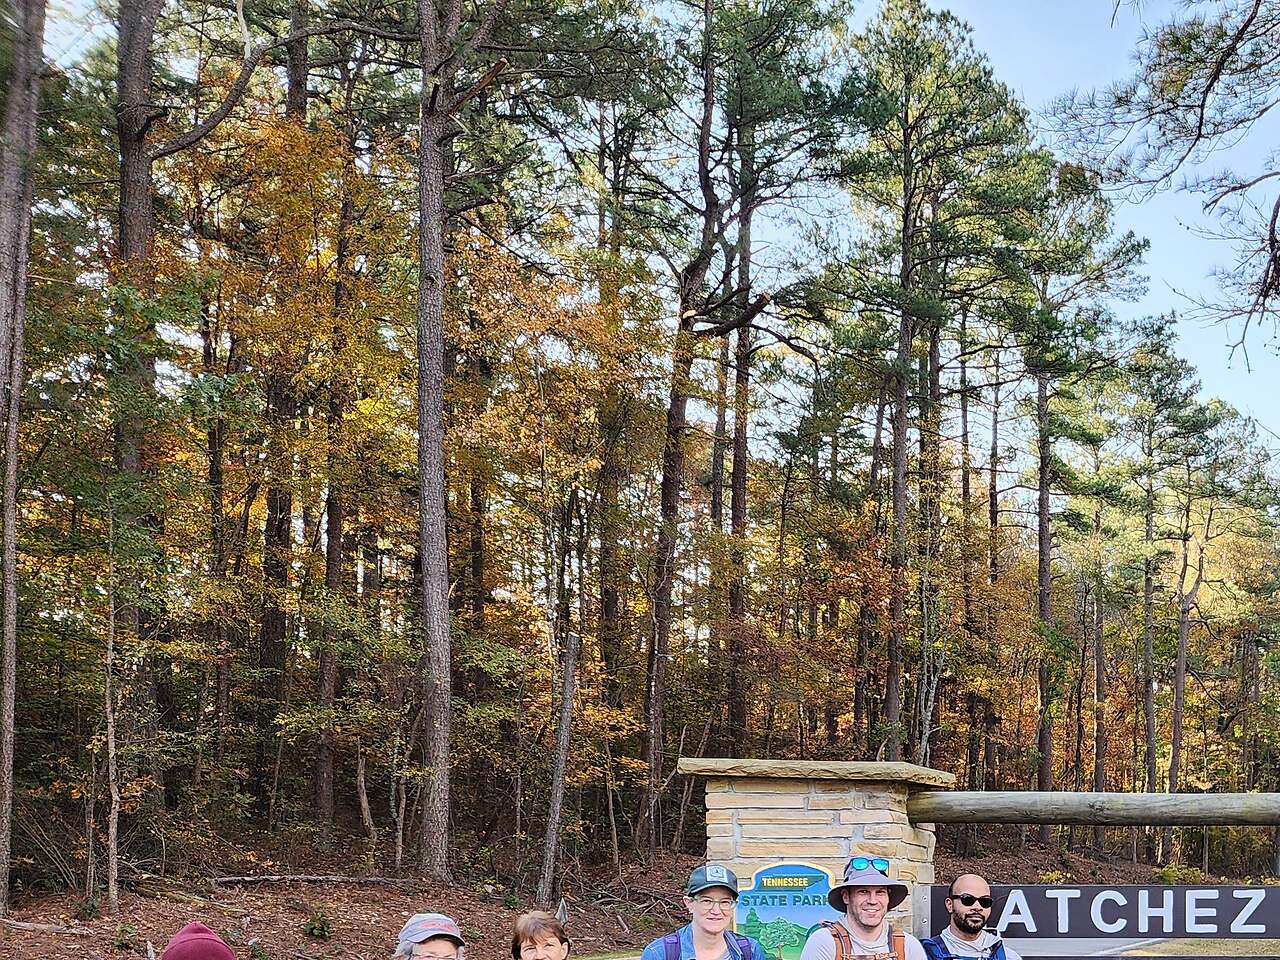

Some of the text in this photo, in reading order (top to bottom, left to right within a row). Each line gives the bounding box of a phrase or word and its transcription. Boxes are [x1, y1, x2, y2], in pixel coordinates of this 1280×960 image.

[762, 877, 809, 887] TENNESSEE
[742, 894, 787, 906] STATE
[998, 888, 1266, 933] ATCHEZ
